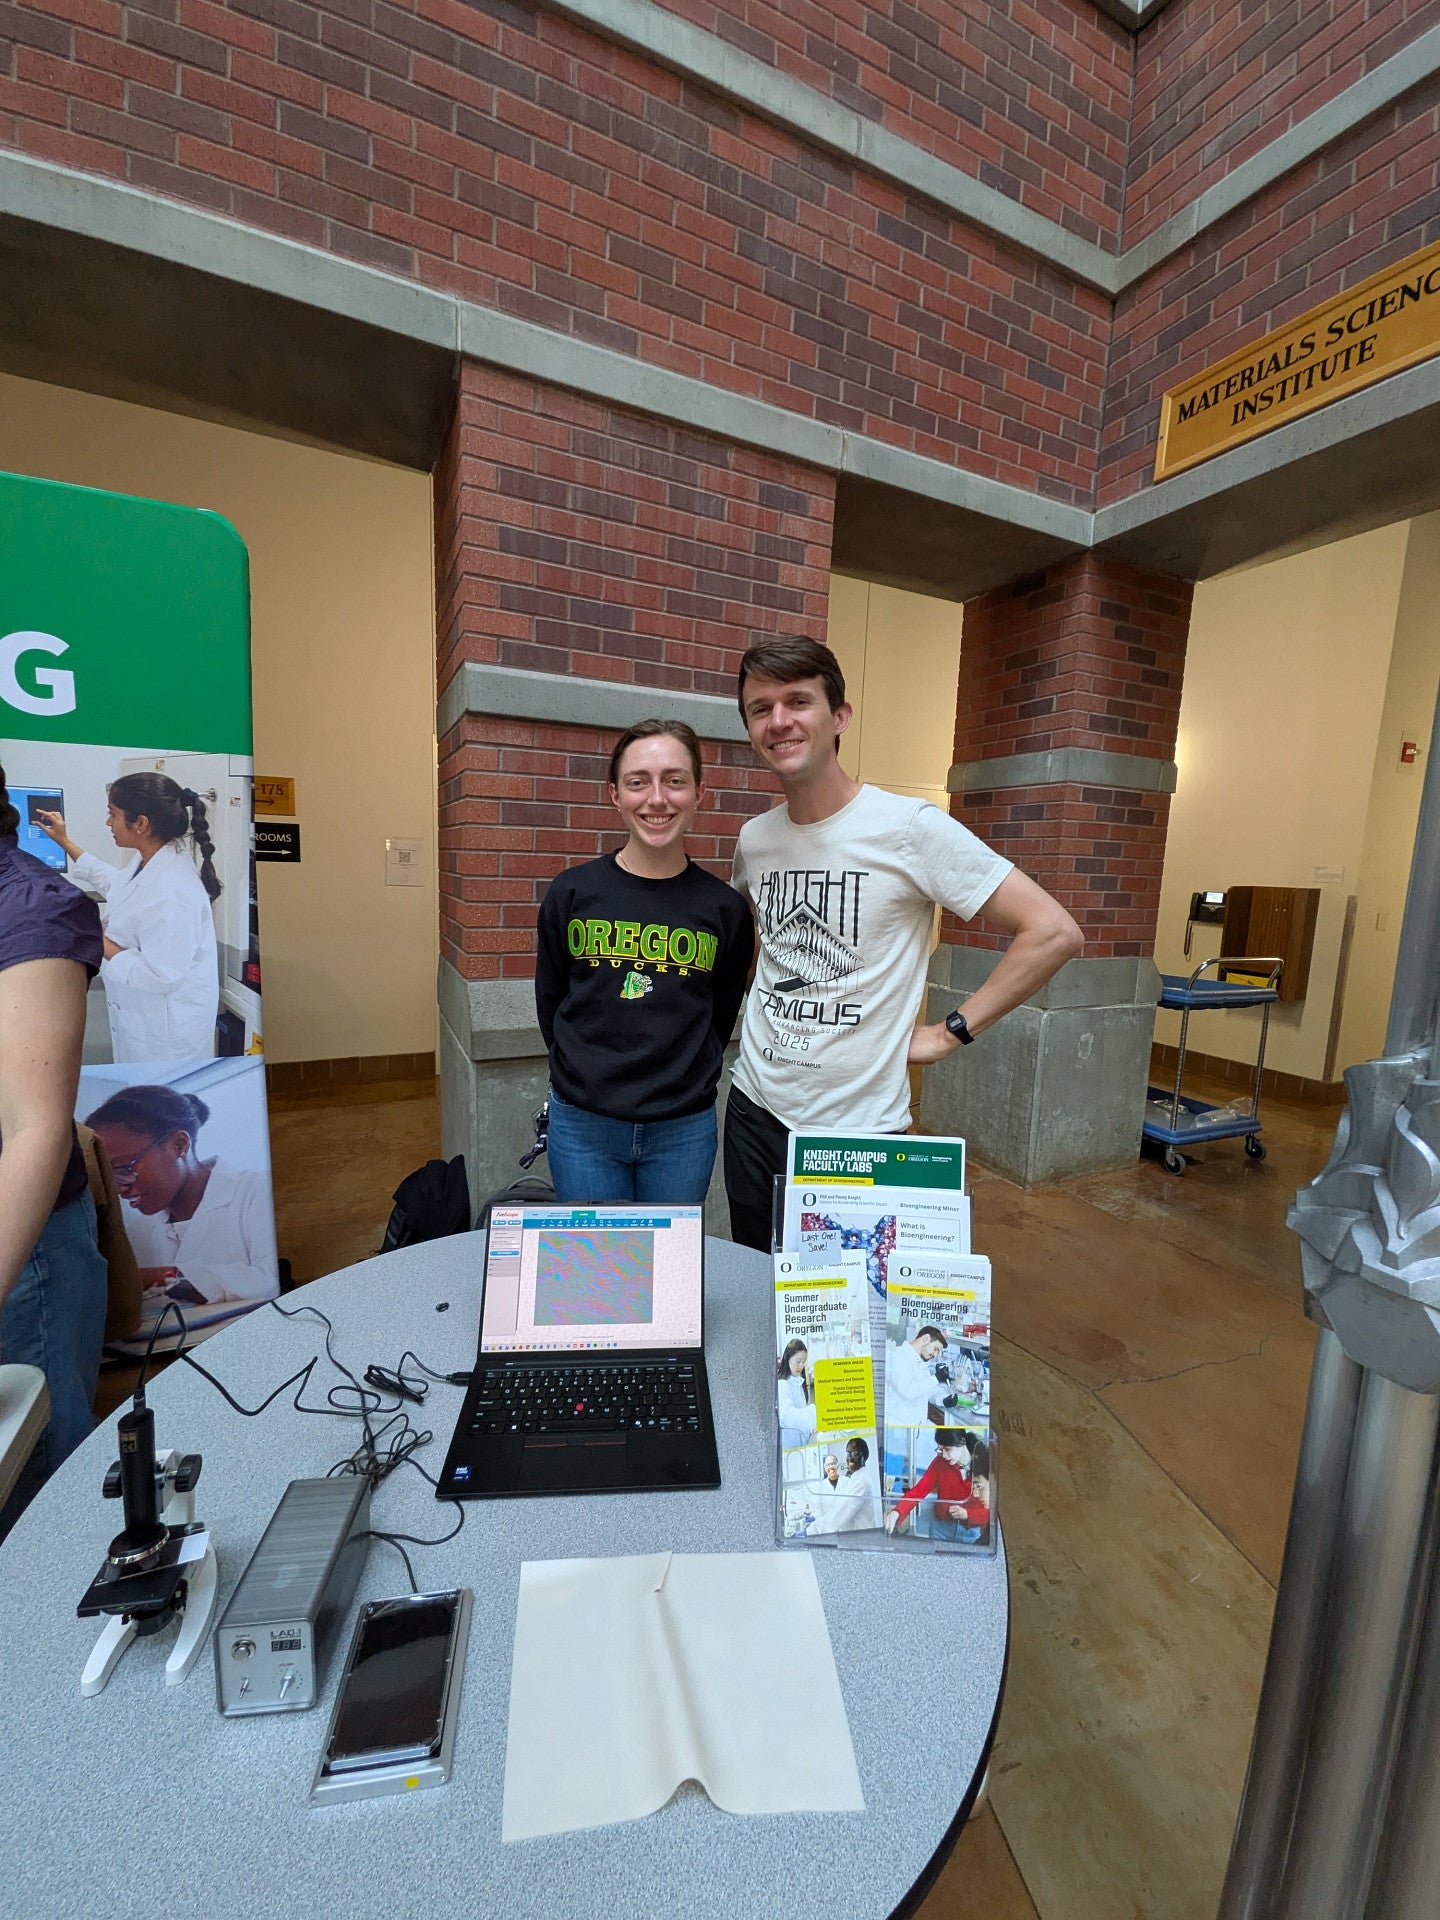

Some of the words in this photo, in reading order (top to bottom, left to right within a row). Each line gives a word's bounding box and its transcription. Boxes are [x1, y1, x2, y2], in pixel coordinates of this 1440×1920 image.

[1177, 331, 1316, 425] MATERIALS
[1230, 333, 1378, 426] INSTITUTE
[567, 918, 719, 972] OREGON
[773, 1030, 812, 1051] 2025
[803, 1150, 842, 1161] KNIGHT
[844, 1150, 887, 1163] CAMPUS
[803, 1160, 845, 1172] FACULTY
[846, 1162, 872, 1172] LABS
[900, 1202, 941, 1211] Bioengineering
[900, 1222, 918, 1230] What
[802, 1232, 820, 1242] Last
[822, 1232, 836, 1240] One!
[900, 1231, 954, 1242] Bioengineering?
[808, 1242, 828, 1252] Save!
[784, 1294, 819, 1302] Summer
[784, 1302, 848, 1314] Undergraduate
[901, 1297, 968, 1314] Bioengineering
[785, 1313, 827, 1324] Research
[901, 1307, 918, 1318] PhD
[921, 1310, 959, 1322] Program
[785, 1325, 824, 1336] Program
